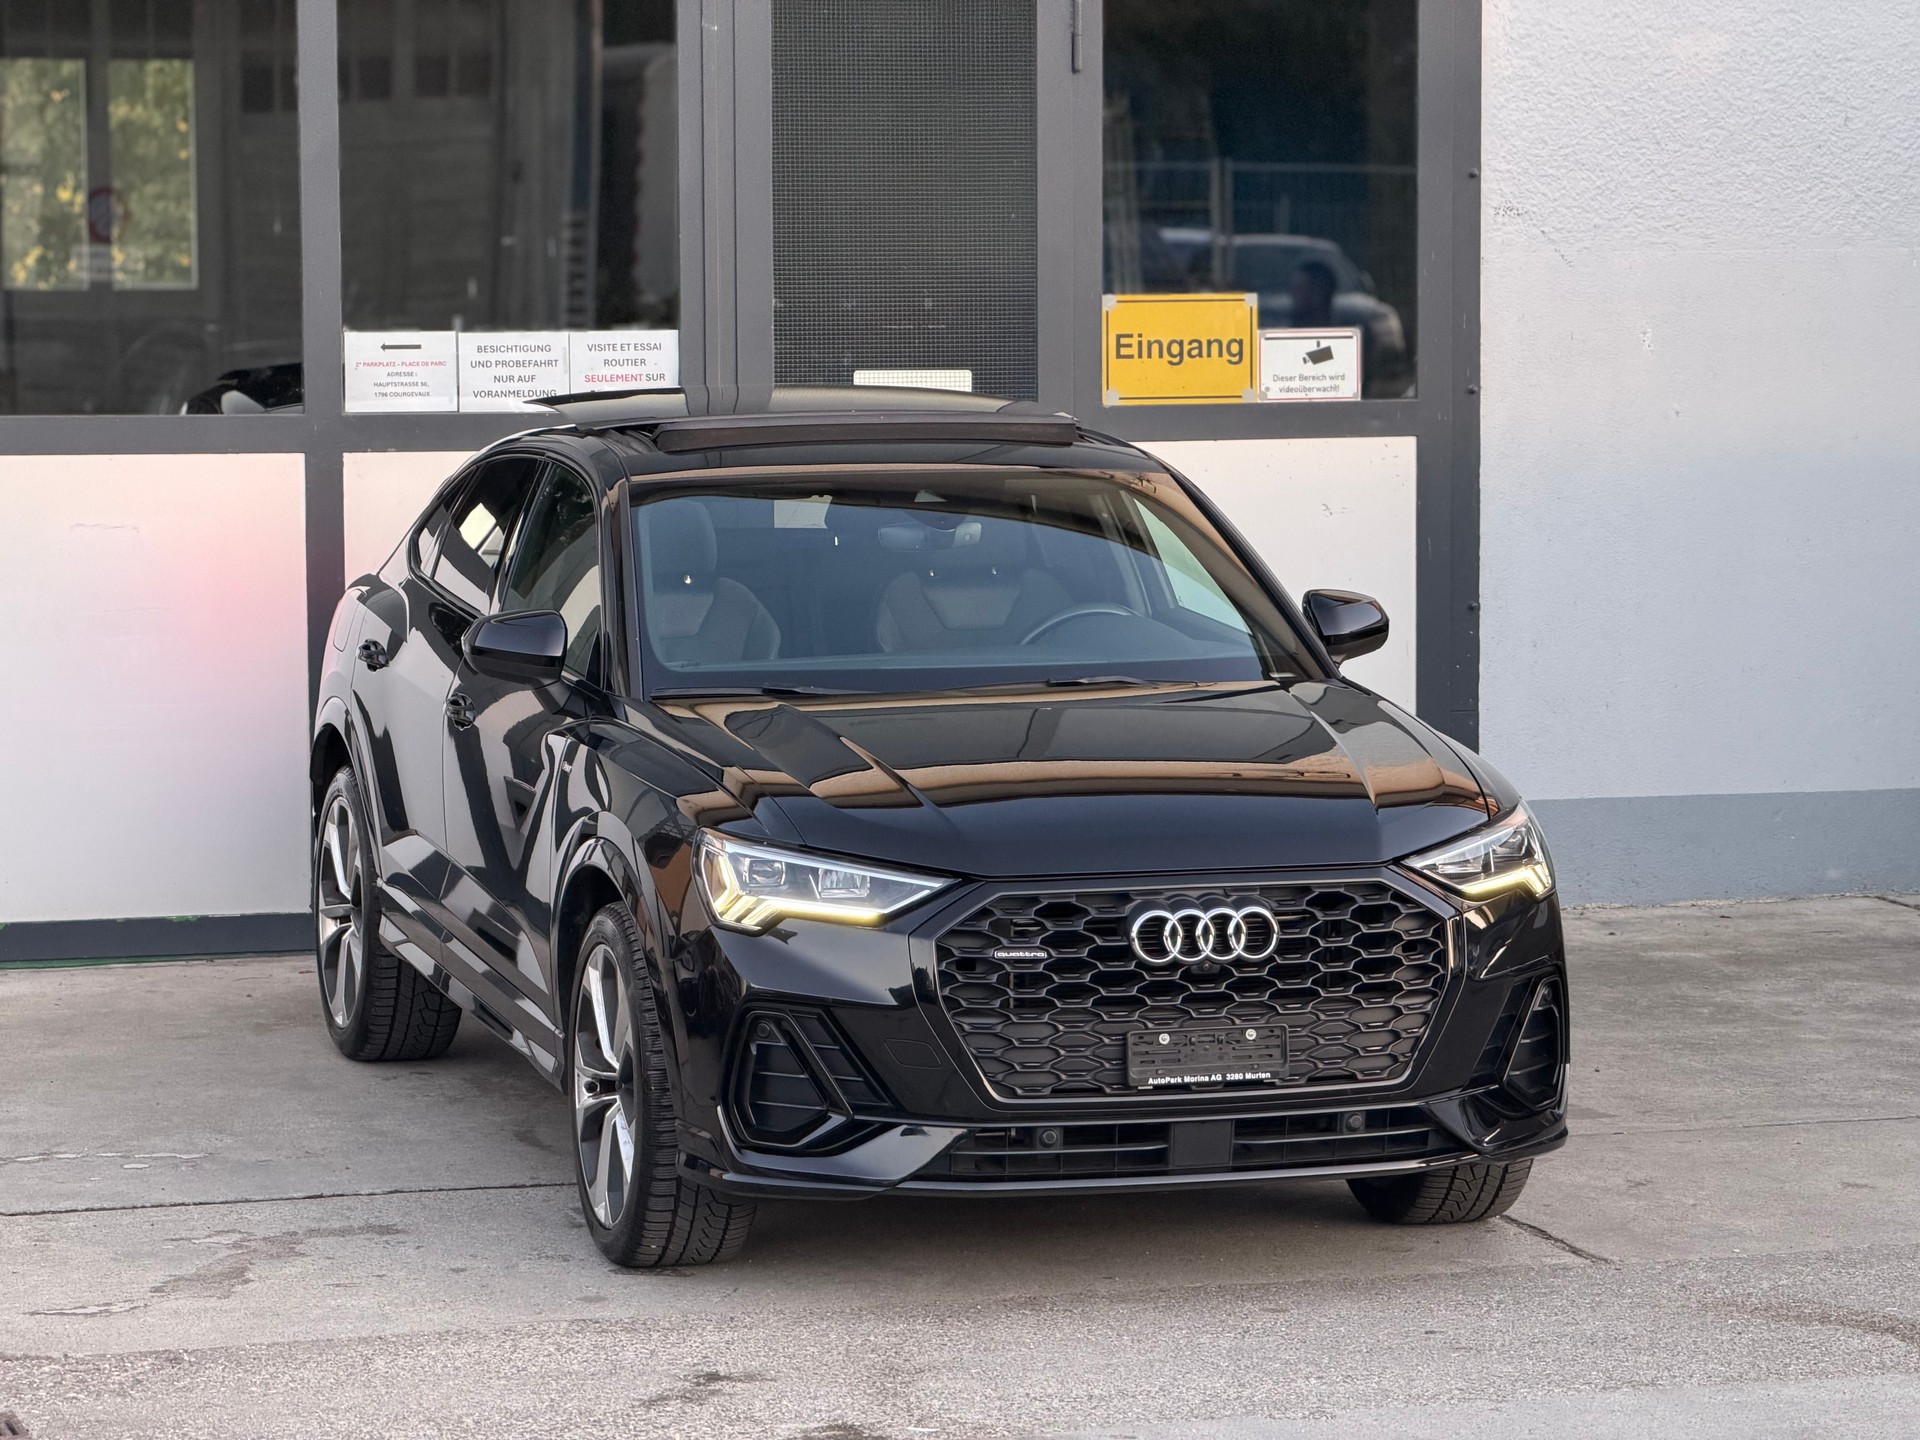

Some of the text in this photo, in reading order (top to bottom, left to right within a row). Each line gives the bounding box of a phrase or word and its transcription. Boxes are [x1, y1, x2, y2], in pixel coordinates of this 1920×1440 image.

[477, 344, 552, 353] BESICHTIGUNG
[587, 342, 662, 352] VISITE ET ESSAI
[1115, 333, 1244, 366] Eingang
[470, 359, 559, 368] UND PROBEFAHRT
[603, 358, 647, 367] ROUTIER
[493, 374, 537, 383] NUR AUF
[584, 373, 666, 383] SEULEMENT SUR
[1272, 373, 1346, 382] Dieser Bereich wird
[1279, 384, 1340, 393] videoüberwacht!
[473, 389, 557, 399] VORANMELDUNG
[997, 951, 1045, 959] quattro
[1148, 1076, 1182, 1085] AutoPark
[1184, 1075, 1209, 1083] Morina
